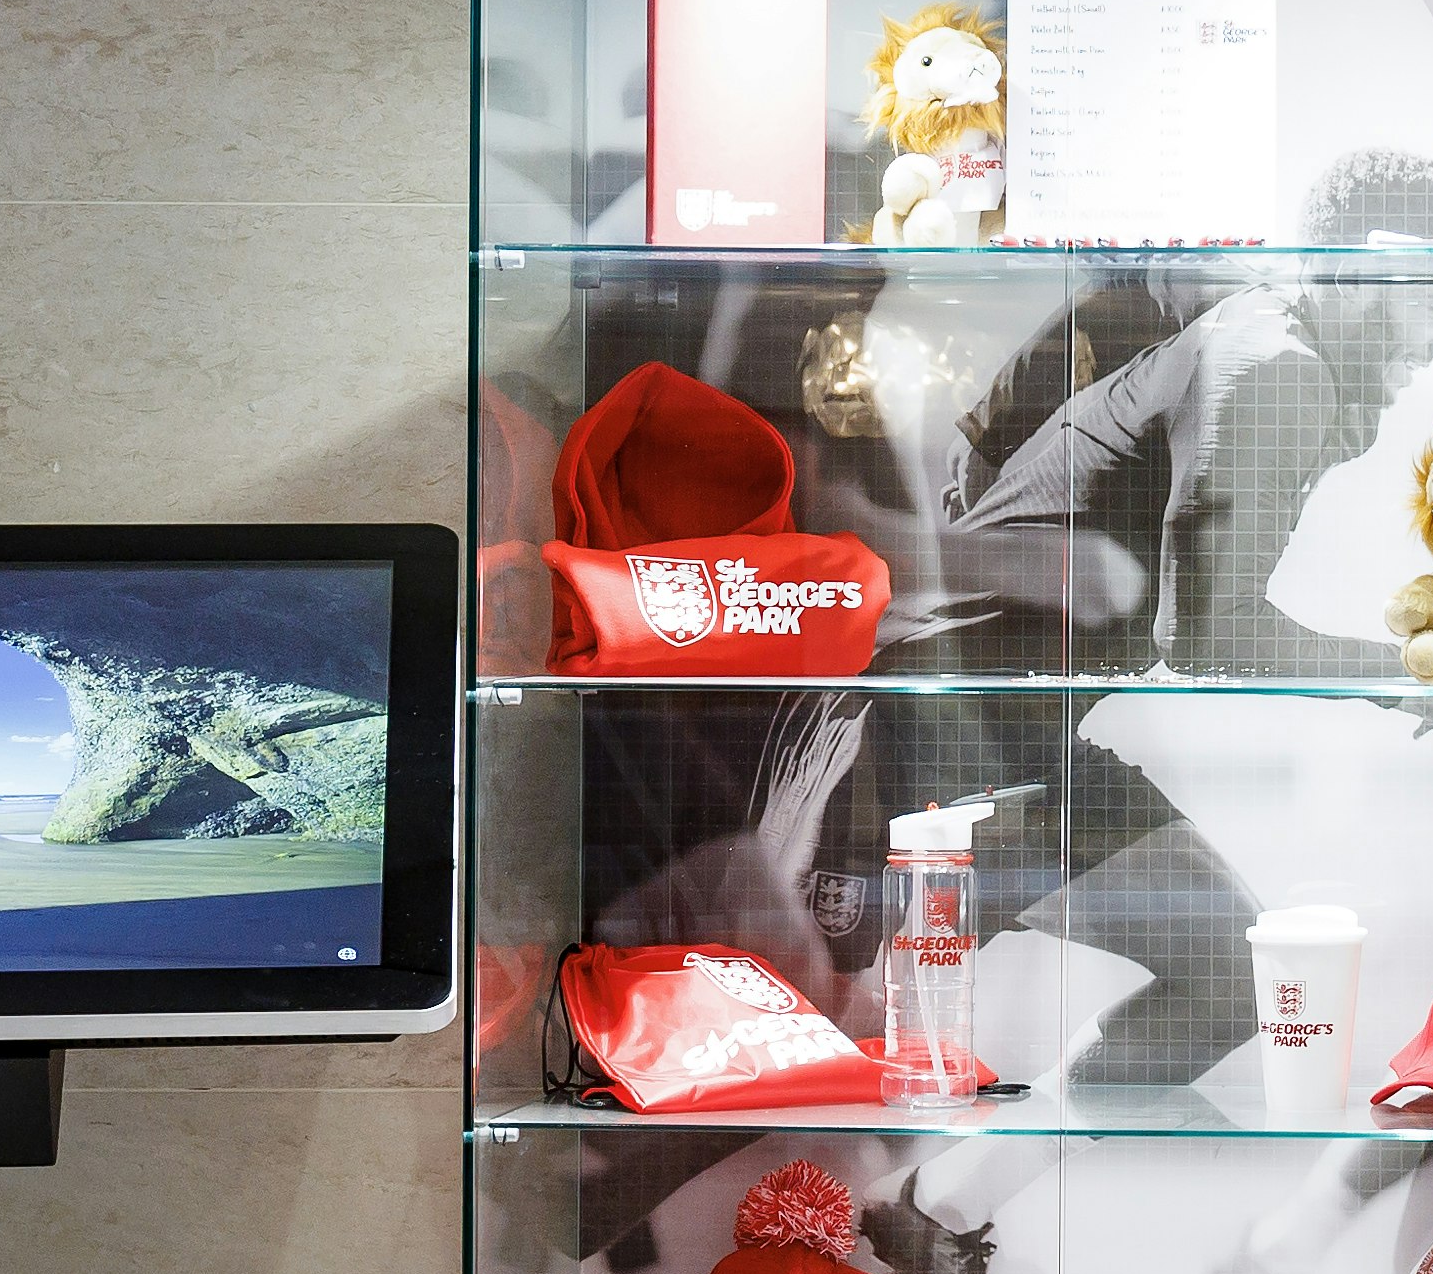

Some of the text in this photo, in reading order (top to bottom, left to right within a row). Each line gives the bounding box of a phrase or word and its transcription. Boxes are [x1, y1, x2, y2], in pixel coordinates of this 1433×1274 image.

[958, 170, 985, 178] PARK
[719, 581, 864, 610] GEORGE'S
[722, 606, 805, 636] PARK
[919, 952, 963, 966] PARK
[1269, 1023, 1333, 1035] GEORGE'S
[1274, 1036, 1308, 1047] PARK
